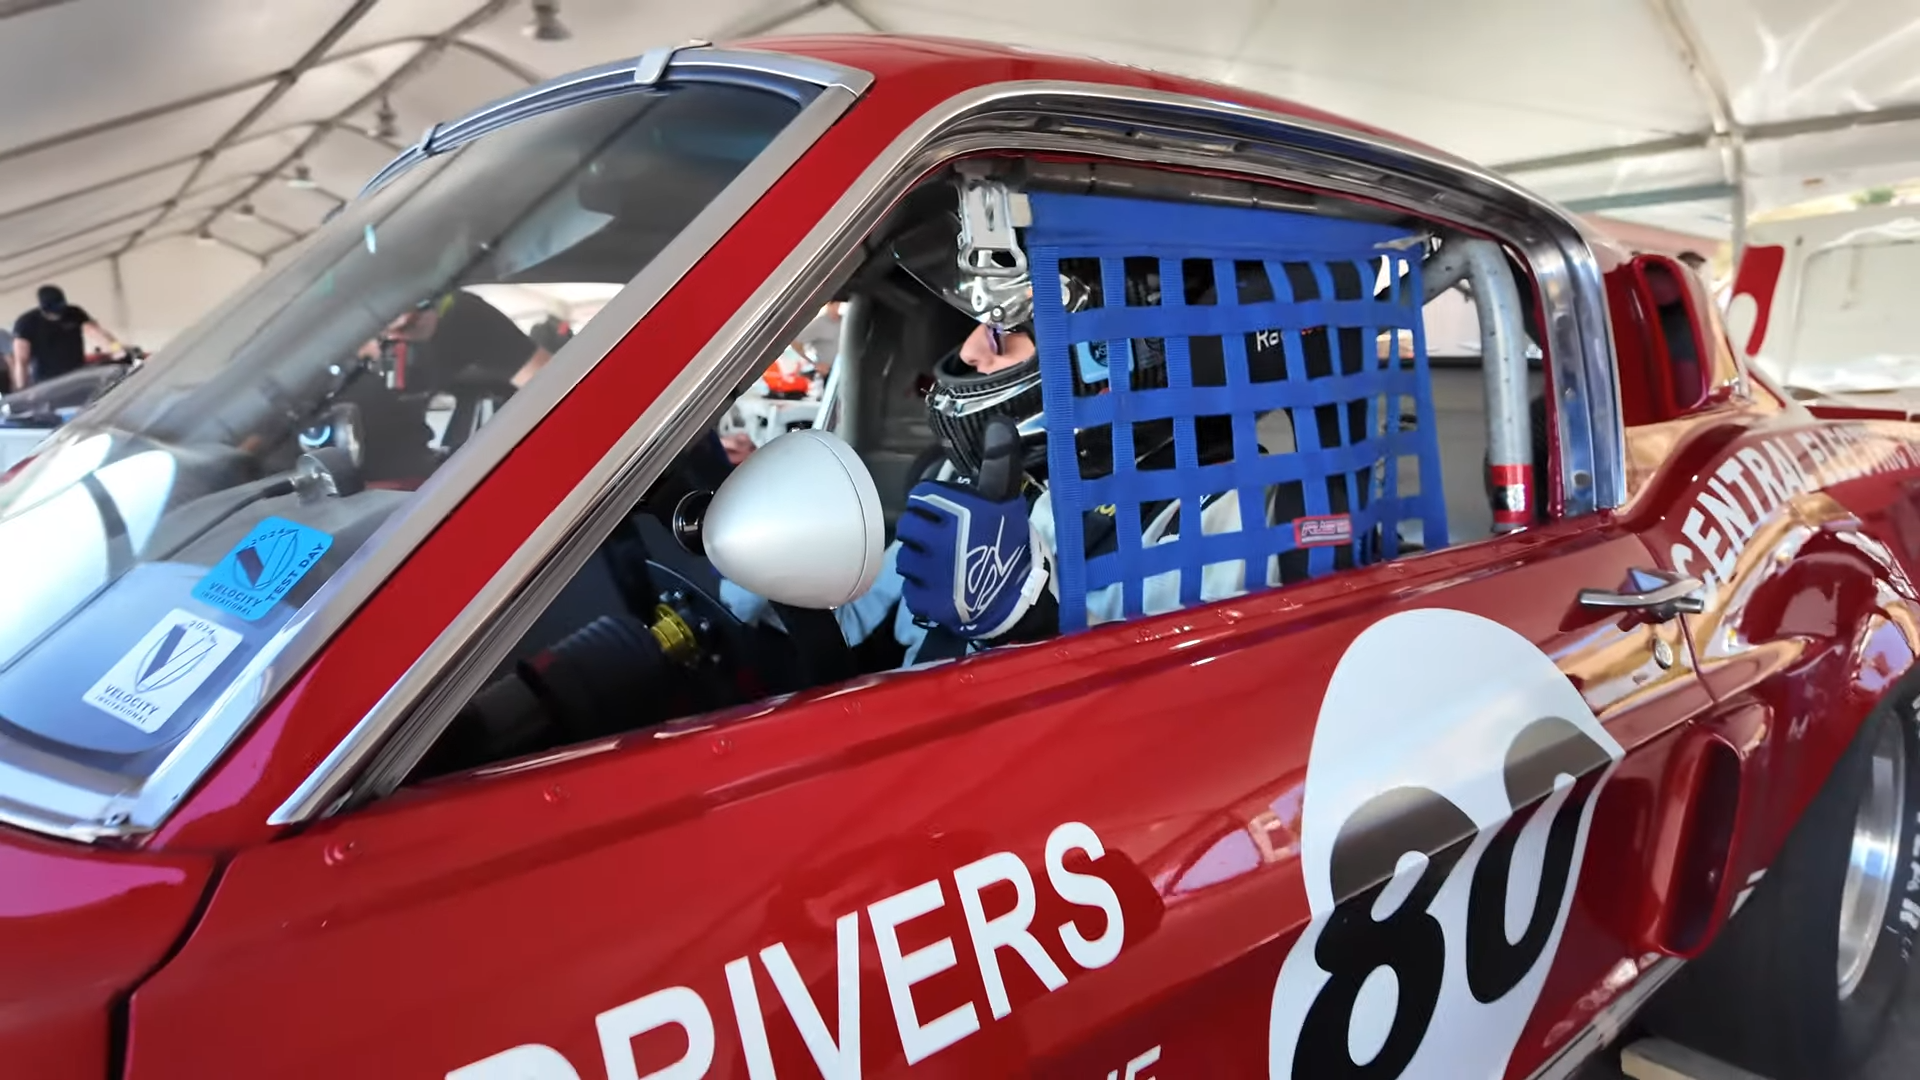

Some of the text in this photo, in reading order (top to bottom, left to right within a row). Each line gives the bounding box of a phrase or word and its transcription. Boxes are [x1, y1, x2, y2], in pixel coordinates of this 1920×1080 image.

[251, 527, 287, 546] 2024
[265, 542, 325, 602] TEST DAY
[201, 591, 252, 615] INVITATIONAL
[208, 581, 263, 607] VELOCITY
[189, 620, 217, 636] 2024
[104, 684, 160, 716] VELOCITY
[1291, 716, 1613, 1080] 80
